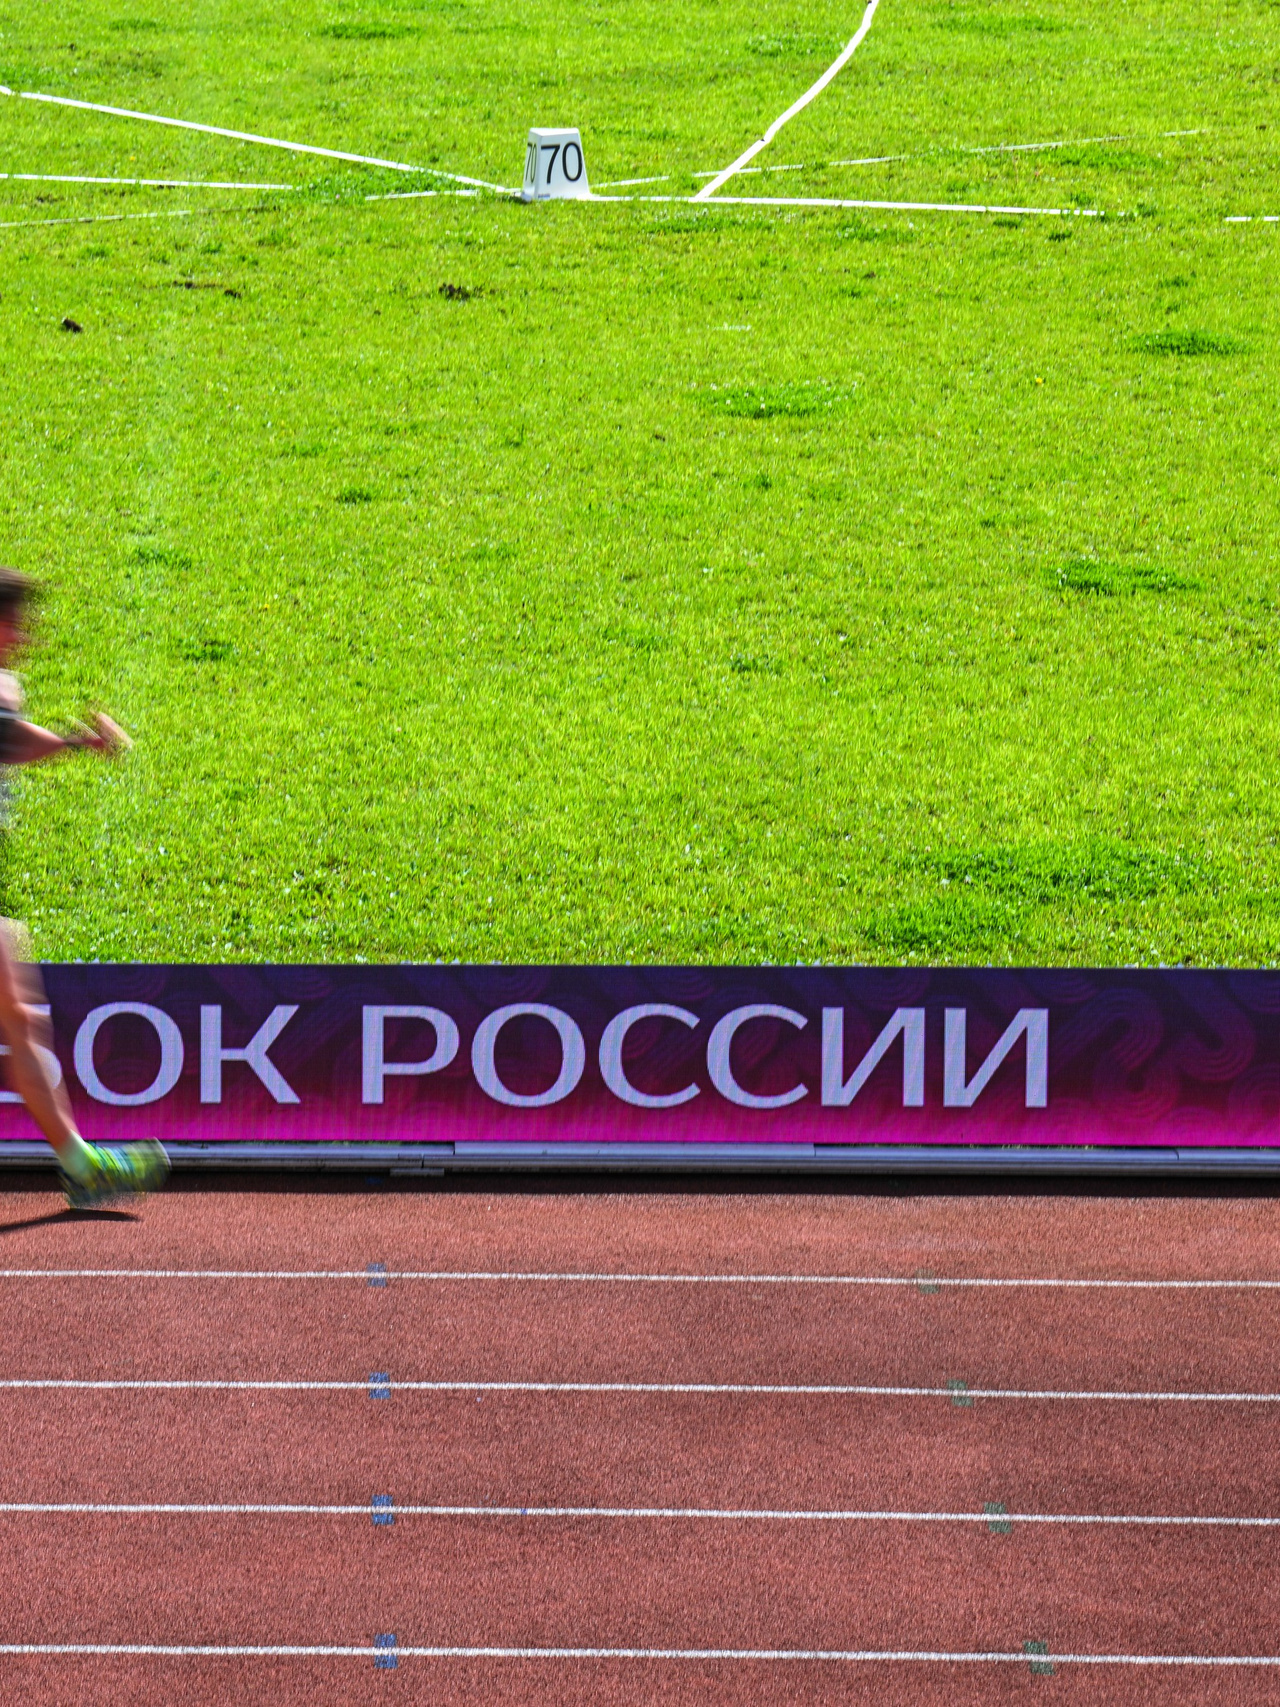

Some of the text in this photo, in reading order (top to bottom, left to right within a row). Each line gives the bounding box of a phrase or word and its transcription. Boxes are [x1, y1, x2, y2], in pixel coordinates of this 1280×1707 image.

[525, 142, 537, 183] 70
[540, 141, 583, 184] 70
[361, 1003, 1050, 1109] РОССИИ
